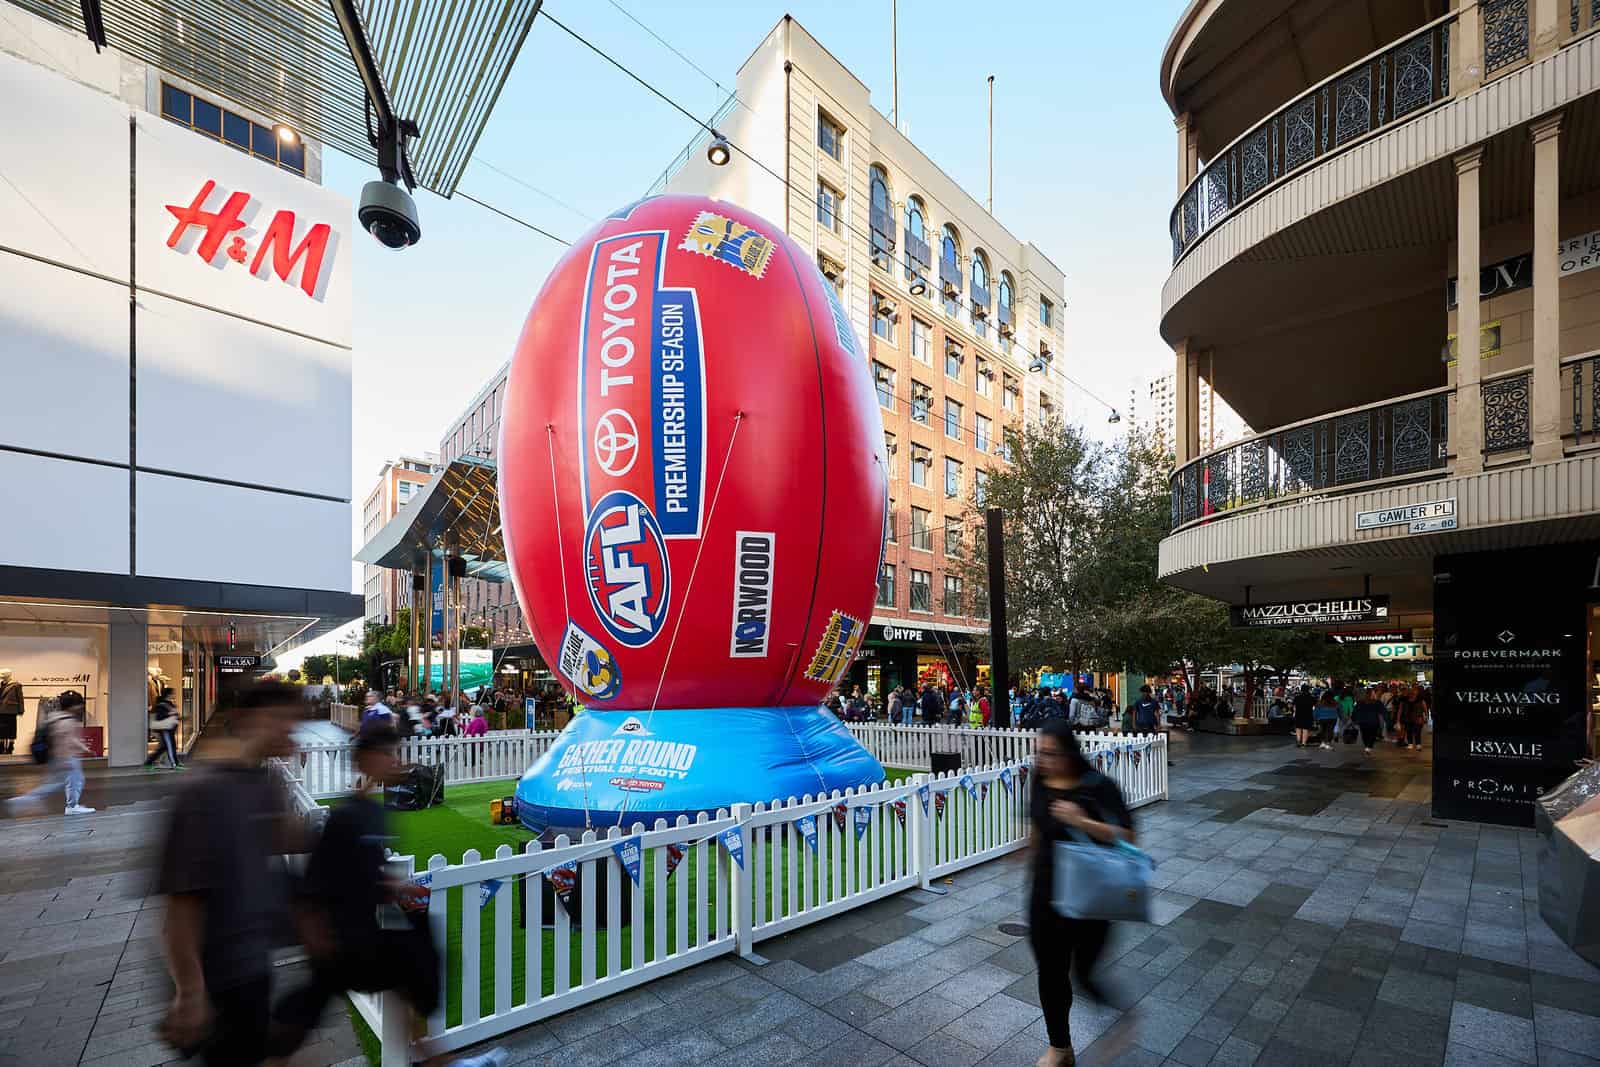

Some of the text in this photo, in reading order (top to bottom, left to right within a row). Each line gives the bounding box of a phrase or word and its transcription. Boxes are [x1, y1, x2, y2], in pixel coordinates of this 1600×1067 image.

[164, 179, 332, 298] H&M
[600, 240, 644, 397] TOYOTA
[661, 304, 689, 513] PREMIERSHIP SEASON
[1378, 506, 1427, 522] GAWLER
[1434, 503, 1451, 515] PL
[1414, 522, 1426, 531] 42
[600, 503, 653, 632] AFL
[735, 536, 770, 653] NORWOOD
[1242, 599, 1372, 618] MAZZUCCHELLI'S
[894, 628, 923, 641] HYPE
[1454, 649, 1561, 658] FOREVERMARK
[559, 740, 697, 771] GATHER ROUND
[1470, 740, 1543, 756] ROYALE
[561, 765, 616, 776] FESTIVAL
[618, 765, 637, 773] OF
[639, 767, 689, 780] FOOTY
